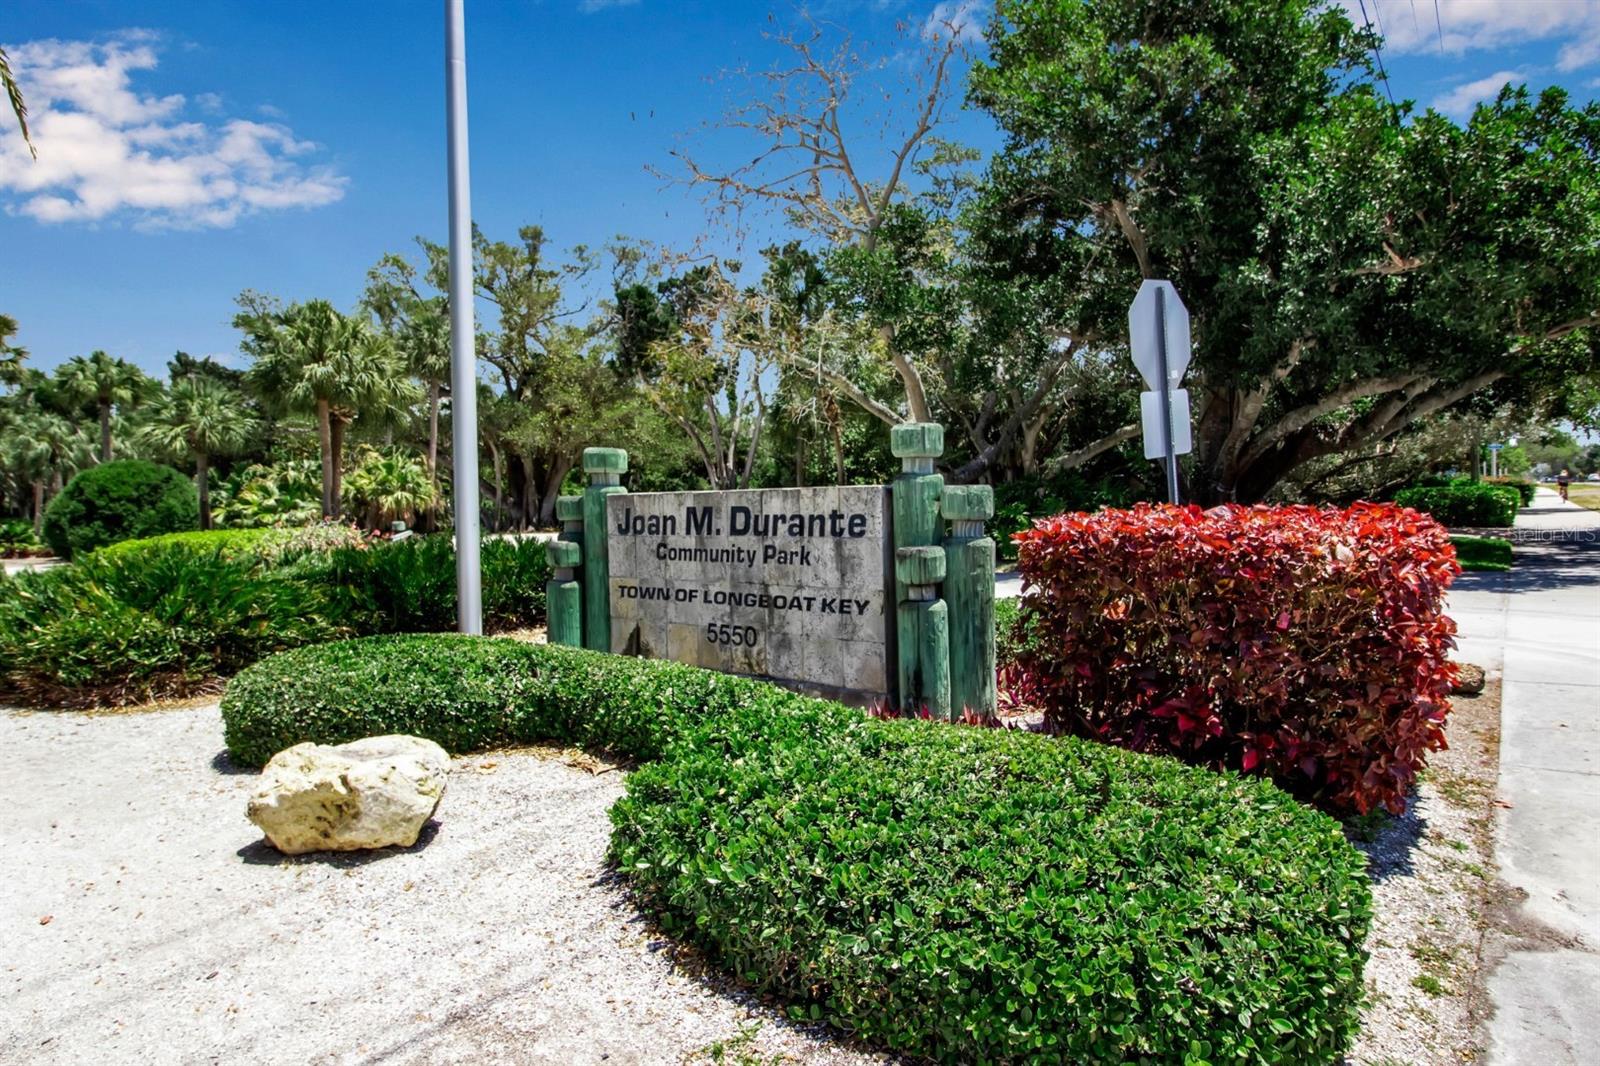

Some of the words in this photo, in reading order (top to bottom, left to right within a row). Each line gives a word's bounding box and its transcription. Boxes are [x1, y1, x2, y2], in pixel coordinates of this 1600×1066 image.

[617, 508, 676, 536] Joan
[686, 506, 721, 536] M.
[729, 505, 867, 538] Durante
[655, 542, 757, 567] Community
[763, 545, 811, 566] Park
[618, 585, 671, 601] TOWN
[674, 588, 699, 603] OF
[703, 590, 816, 612] LONGBOAT
[821, 597, 870, 616] KEY
[706, 623, 757, 648] 5550
